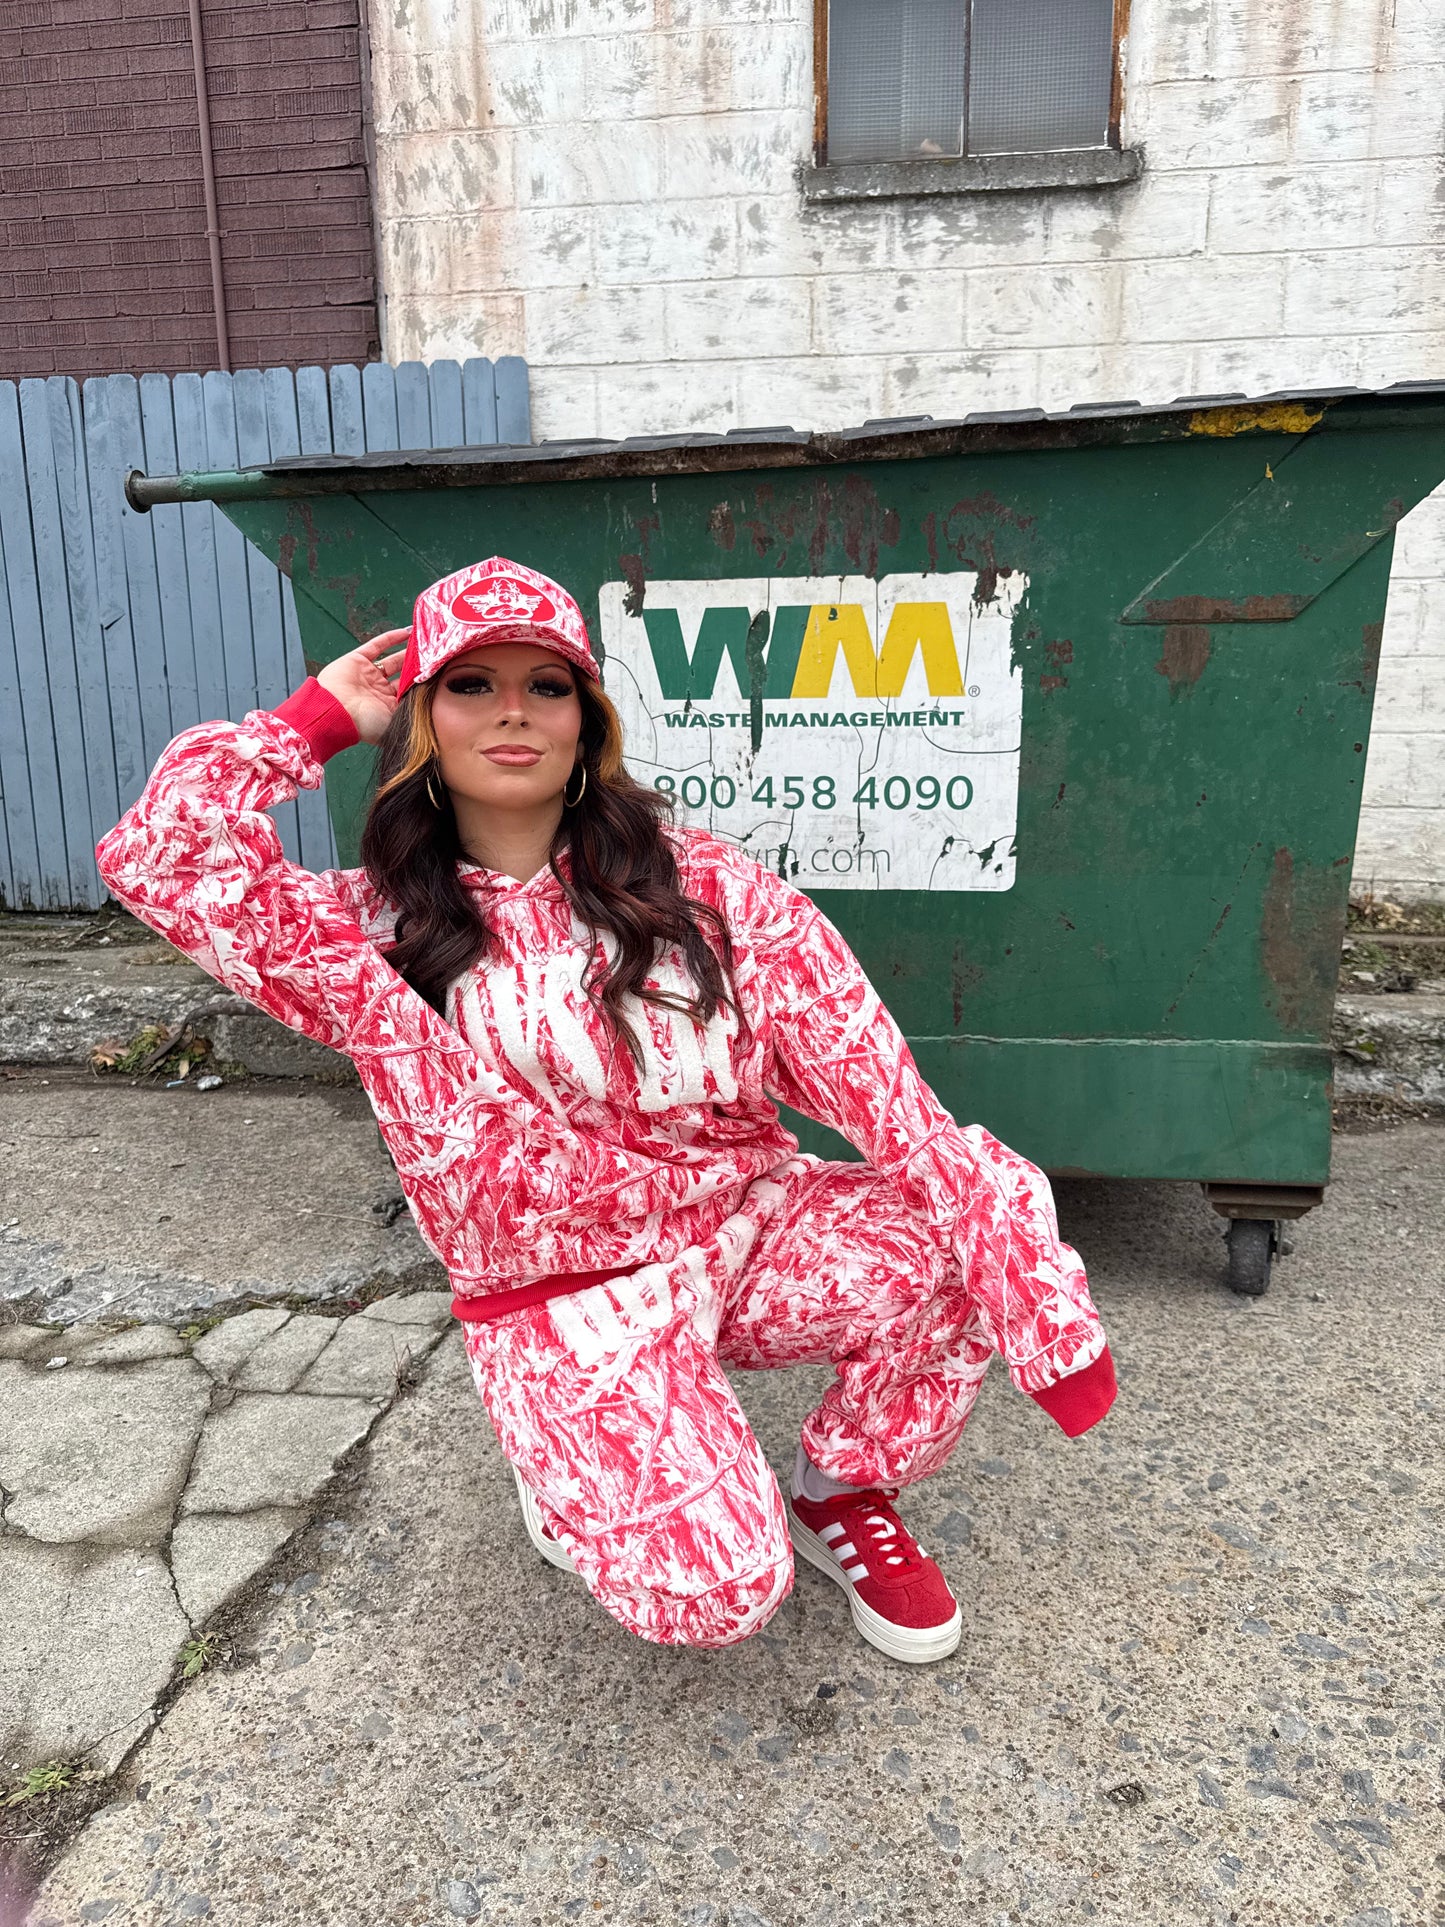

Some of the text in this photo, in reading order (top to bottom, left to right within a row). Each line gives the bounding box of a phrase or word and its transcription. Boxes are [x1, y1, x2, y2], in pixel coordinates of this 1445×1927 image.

[643, 602, 966, 700] WM
[664, 711, 965, 728] WASTE MANAGEMENT
[654, 775, 974, 810] 800 458 4090
